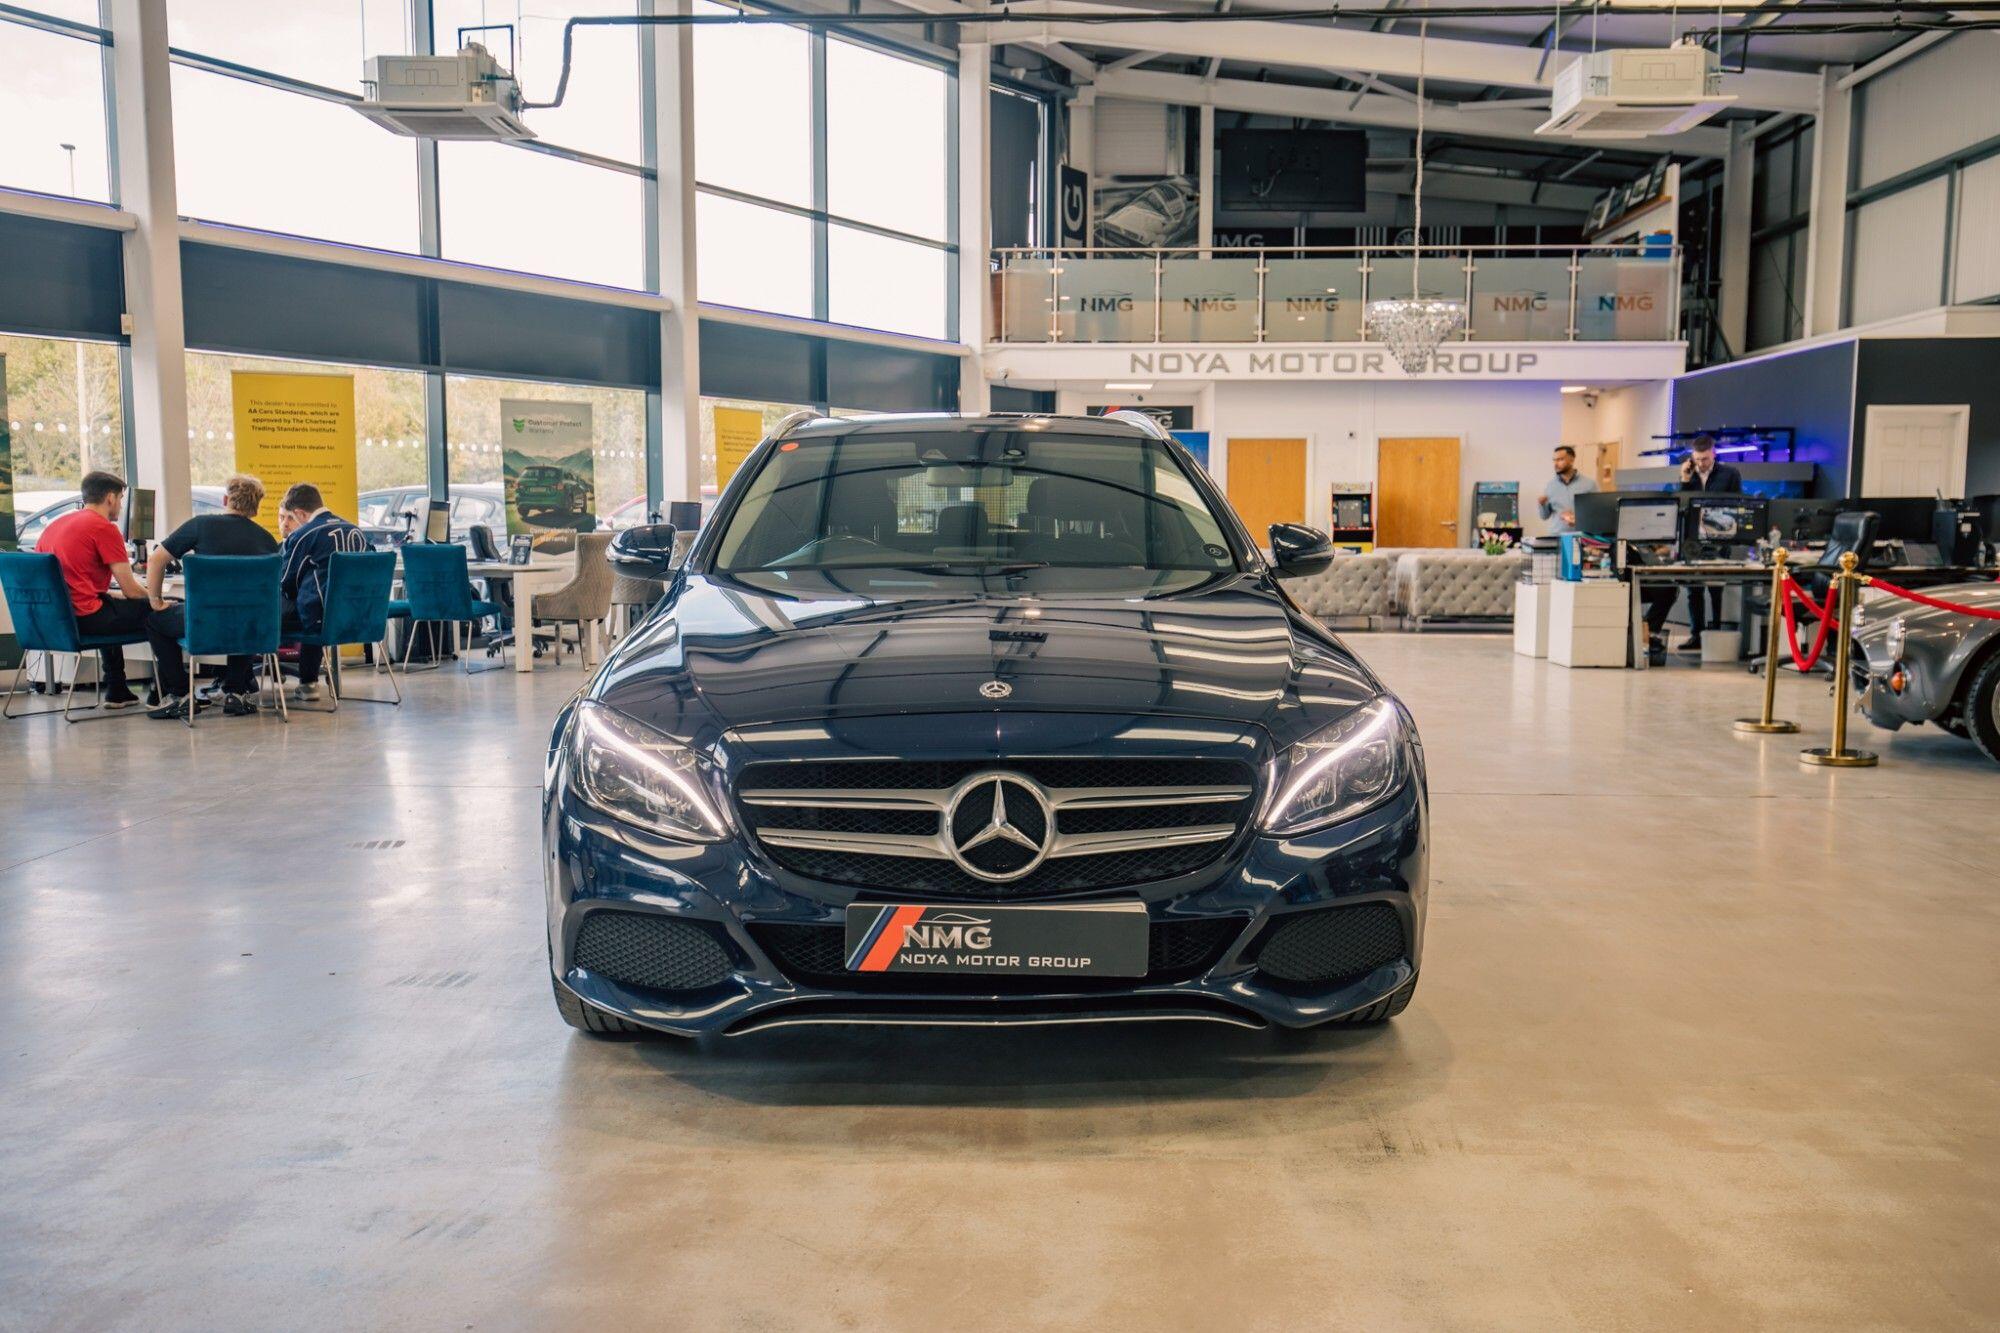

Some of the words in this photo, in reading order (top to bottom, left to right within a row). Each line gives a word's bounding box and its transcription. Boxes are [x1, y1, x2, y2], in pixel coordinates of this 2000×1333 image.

[1213, 234, 1264, 247] MG
[1081, 297, 1134, 312] NMG
[1183, 297, 1237, 312] NMG
[1286, 297, 1340, 312] NMG
[1494, 297, 1547, 311] NMG
[1598, 296, 1653, 311] NMG
[1130, 353, 1230, 373] NOYA
[1249, 353, 1384, 373] MOTOR
[328, 527, 367, 552] 10
[902, 924, 993, 950] NMG
[900, 953, 949, 965] NOYA
[956, 954, 1020, 967] MOTOR
[1028, 955, 1092, 968] GROUP
